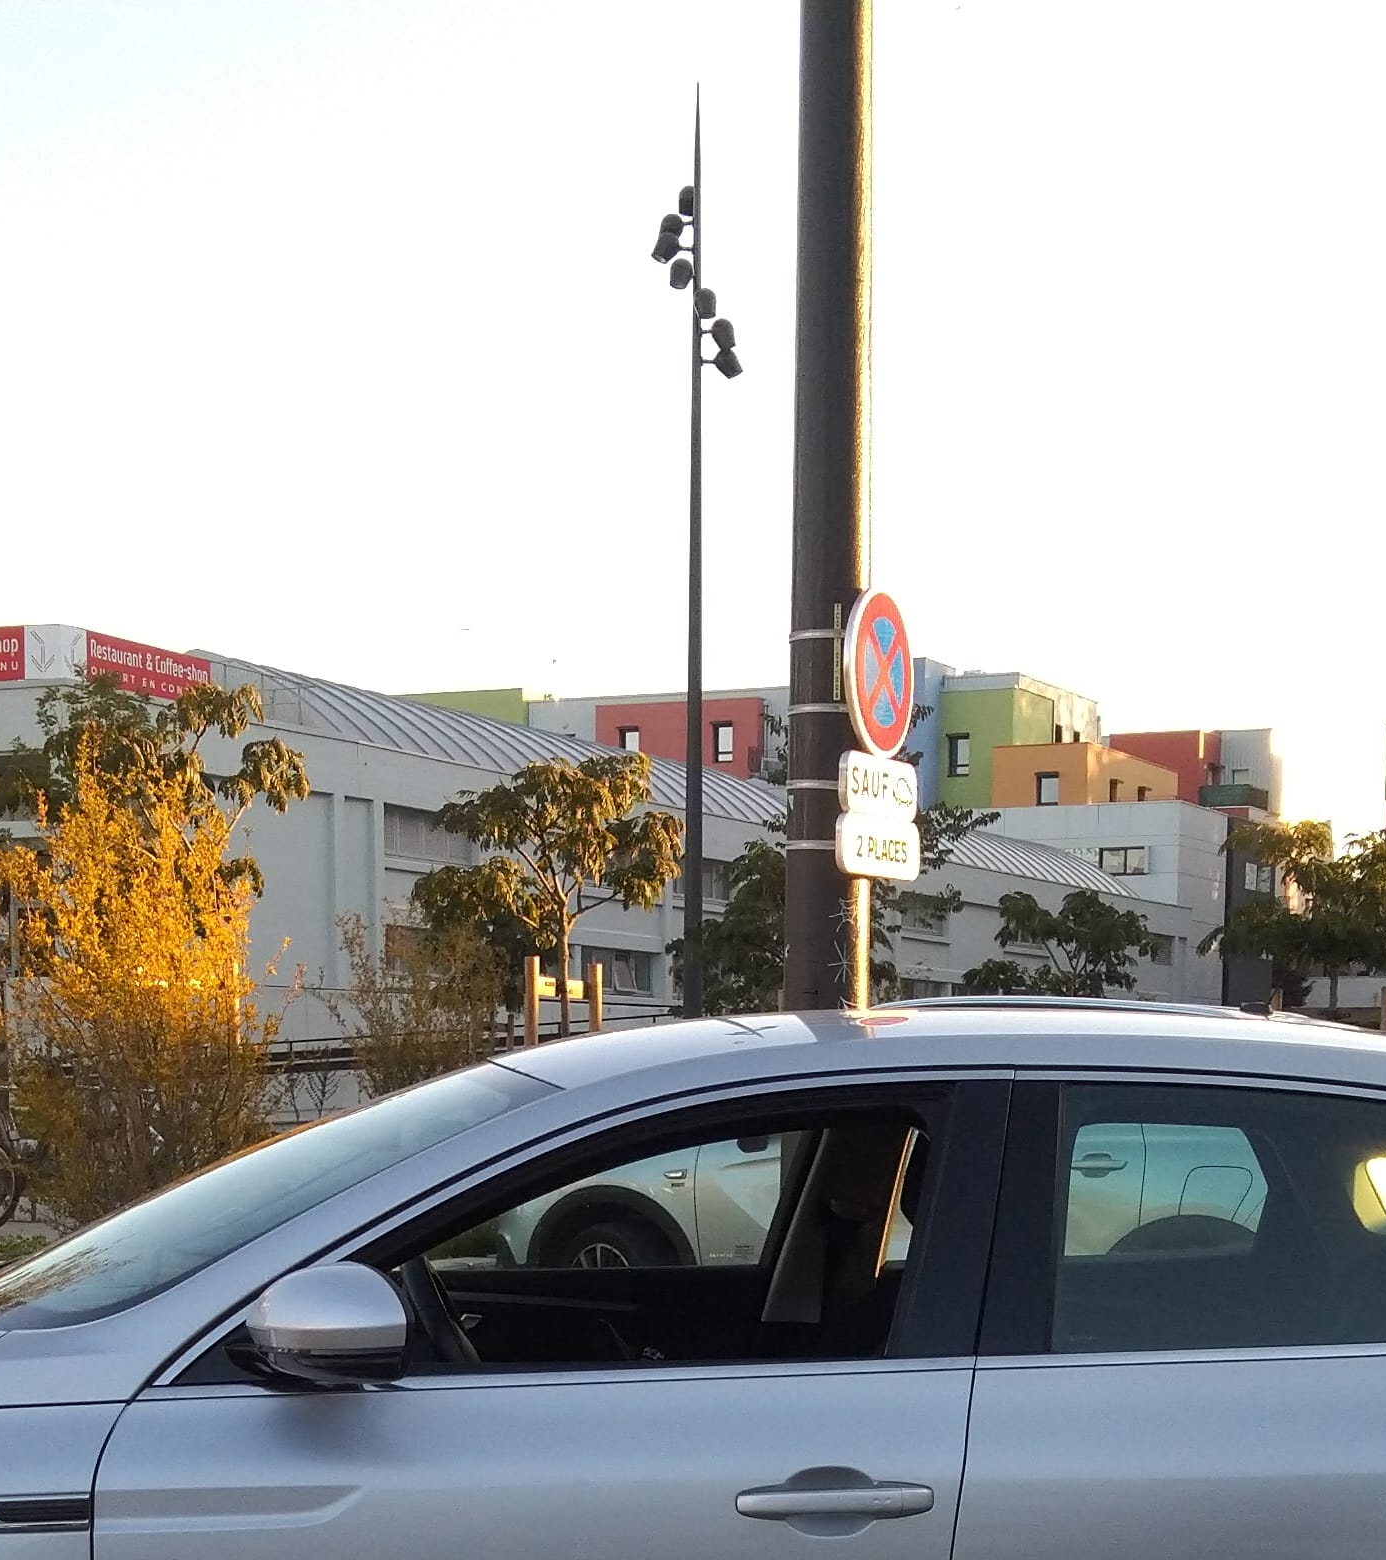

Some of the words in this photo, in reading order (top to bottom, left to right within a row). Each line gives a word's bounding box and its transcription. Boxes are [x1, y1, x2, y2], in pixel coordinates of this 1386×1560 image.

[90, 638, 143, 669] Restaurant
[146, 652, 153, 671] &
[155, 655, 208, 682] Coffee-shop
[142, 677, 155, 689] EN
[851, 765, 889, 800] SAUF
[856, 835, 863, 858] 2
[868, 835, 907, 864] PLACES
